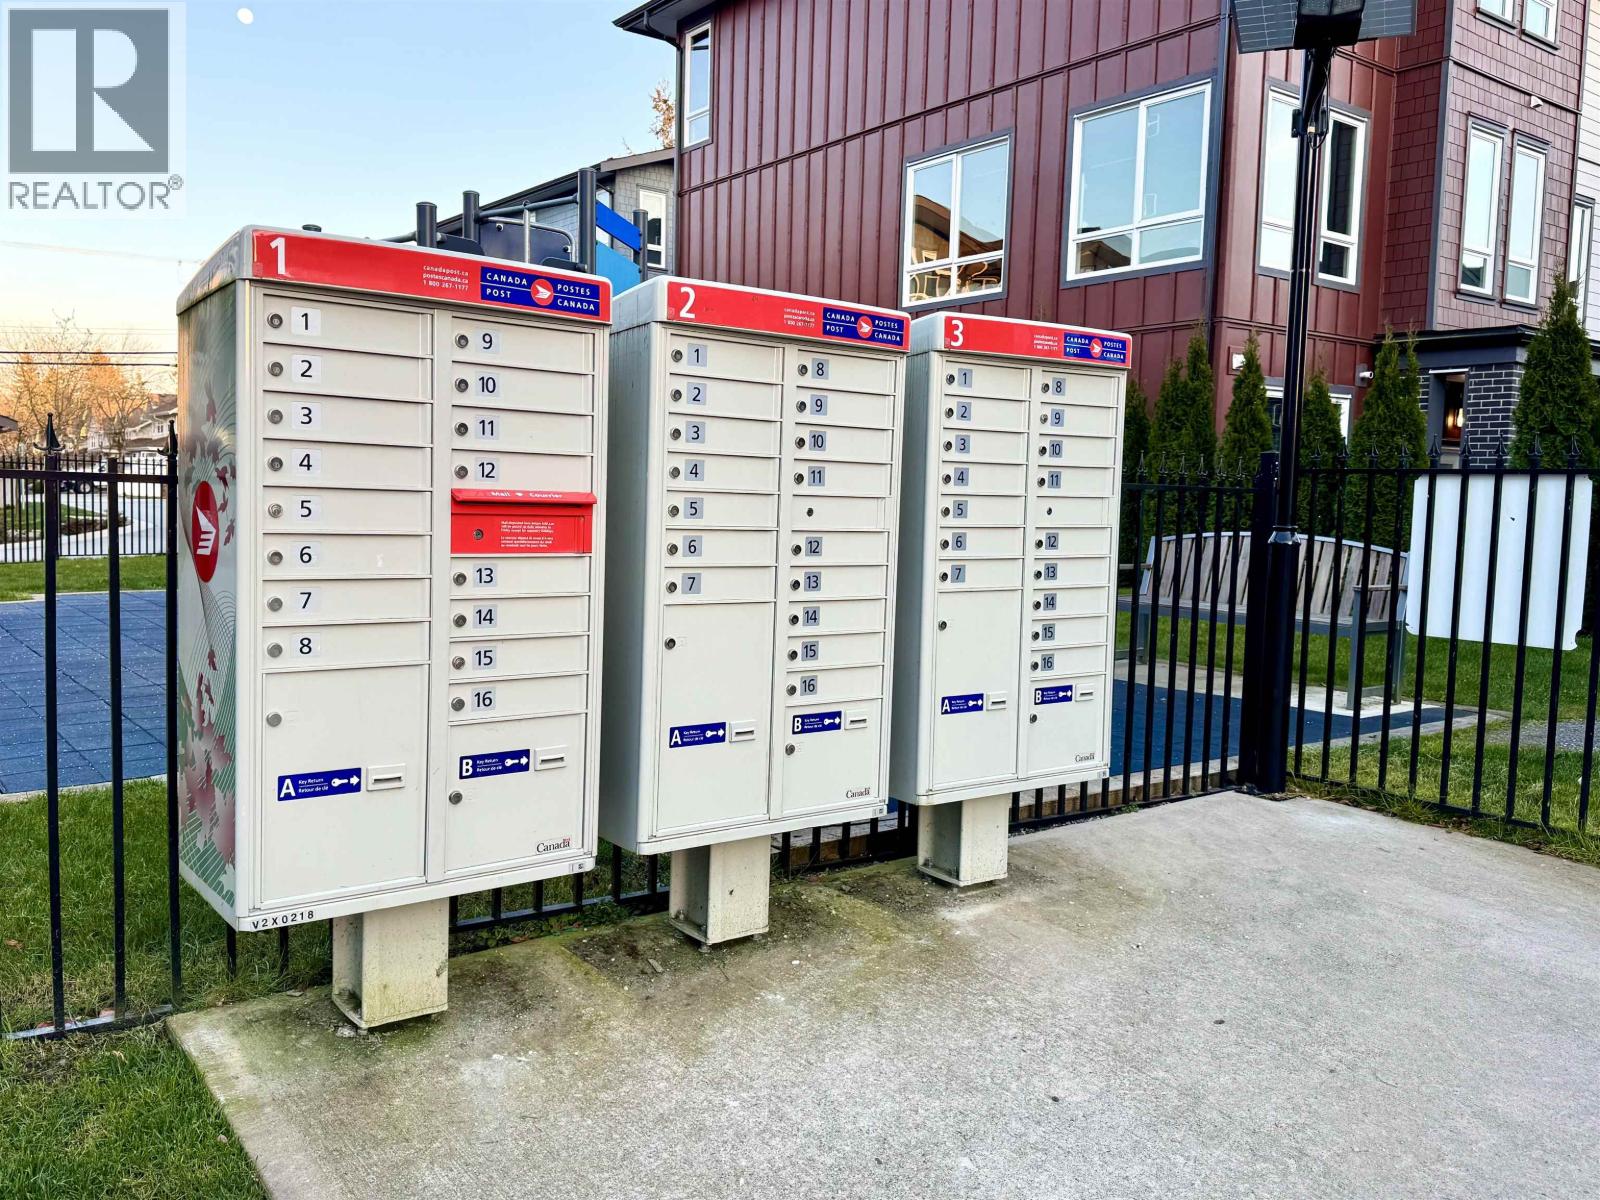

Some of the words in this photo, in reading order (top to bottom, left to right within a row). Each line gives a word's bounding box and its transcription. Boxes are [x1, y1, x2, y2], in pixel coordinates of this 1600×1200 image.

[270, 237, 287, 275] 1
[486, 272, 528, 286] CANADA
[486, 288, 511, 298] POST
[557, 284, 591, 296] POSTES
[557, 299, 595, 311] CANADA
[679, 286, 696, 319] 2
[301, 312, 309, 331] 1
[826, 312, 855, 322] CANADA
[875, 320, 898, 329] POSTES
[826, 325, 844, 333] POST
[950, 320, 964, 347] 3
[482, 332, 493, 350] 9
[874, 332, 901, 342] CANADA
[1066, 336, 1089, 345] CANADA
[1066, 347, 1080, 355] POST
[1104, 341, 1122, 349] POSTES
[694, 348, 700, 363] 1
[1103, 352, 1124, 360] CANADA
[300, 359, 313, 378] 2
[816, 362, 825, 377] 8
[478, 376, 496, 394] 10
[962, 372, 967, 385] 1
[692, 386, 701, 402] 2
[1055, 380, 1062, 394] 8
[815, 398, 823, 413] 9
[960, 405, 968, 419] 2
[300, 406, 312, 425] 3
[1054, 412, 1061, 425] 9
[479, 419, 494, 436] 11
[691, 425, 700, 440] 3
[811, 434, 824, 449] 10
[959, 438, 966, 451] 3
[1050, 443, 1061, 456] 10
[298, 453, 313, 471] 4
[478, 462, 495, 479] 12
[689, 463, 699, 478] 4
[810, 469, 822, 484] 11
[957, 470, 965, 484] 4
[1050, 473, 1059, 487] 11
[300, 500, 312, 518] 5
[689, 501, 698, 516] 5
[956, 503, 964, 516] 5
[688, 539, 697, 554] 6
[807, 540, 820, 554] 12
[955, 535, 963, 549] 6
[1047, 535, 1057, 548] 12
[299, 545, 312, 564] 6
[476, 567, 494, 584] 13
[955, 567, 962, 580] 7
[1045, 566, 1056, 578] 13
[687, 576, 696, 591] 7
[806, 574, 819, 589] 13
[300, 591, 312, 609] 7
[1044, 596, 1055, 609] 14
[475, 608, 494, 625] 14
[805, 609, 818, 624] 14
[1043, 626, 1054, 639] 15
[299, 637, 312, 655] 8
[803, 644, 817, 659] 15
[475, 649, 493, 666] 15
[1042, 656, 1053, 669] 16
[802, 678, 816, 693] 16
[474, 690, 493, 708] 16
[1036, 690, 1042, 703] B
[941, 699, 951, 713] A
[794, 717, 802, 732] B
[670, 730, 682, 746] A
[462, 759, 473, 777] B
[280, 778, 296, 798] A
[846, 788, 870, 799] Canada
[536, 839, 570, 854] Canada
[252, 910, 315, 929] V2X0218
